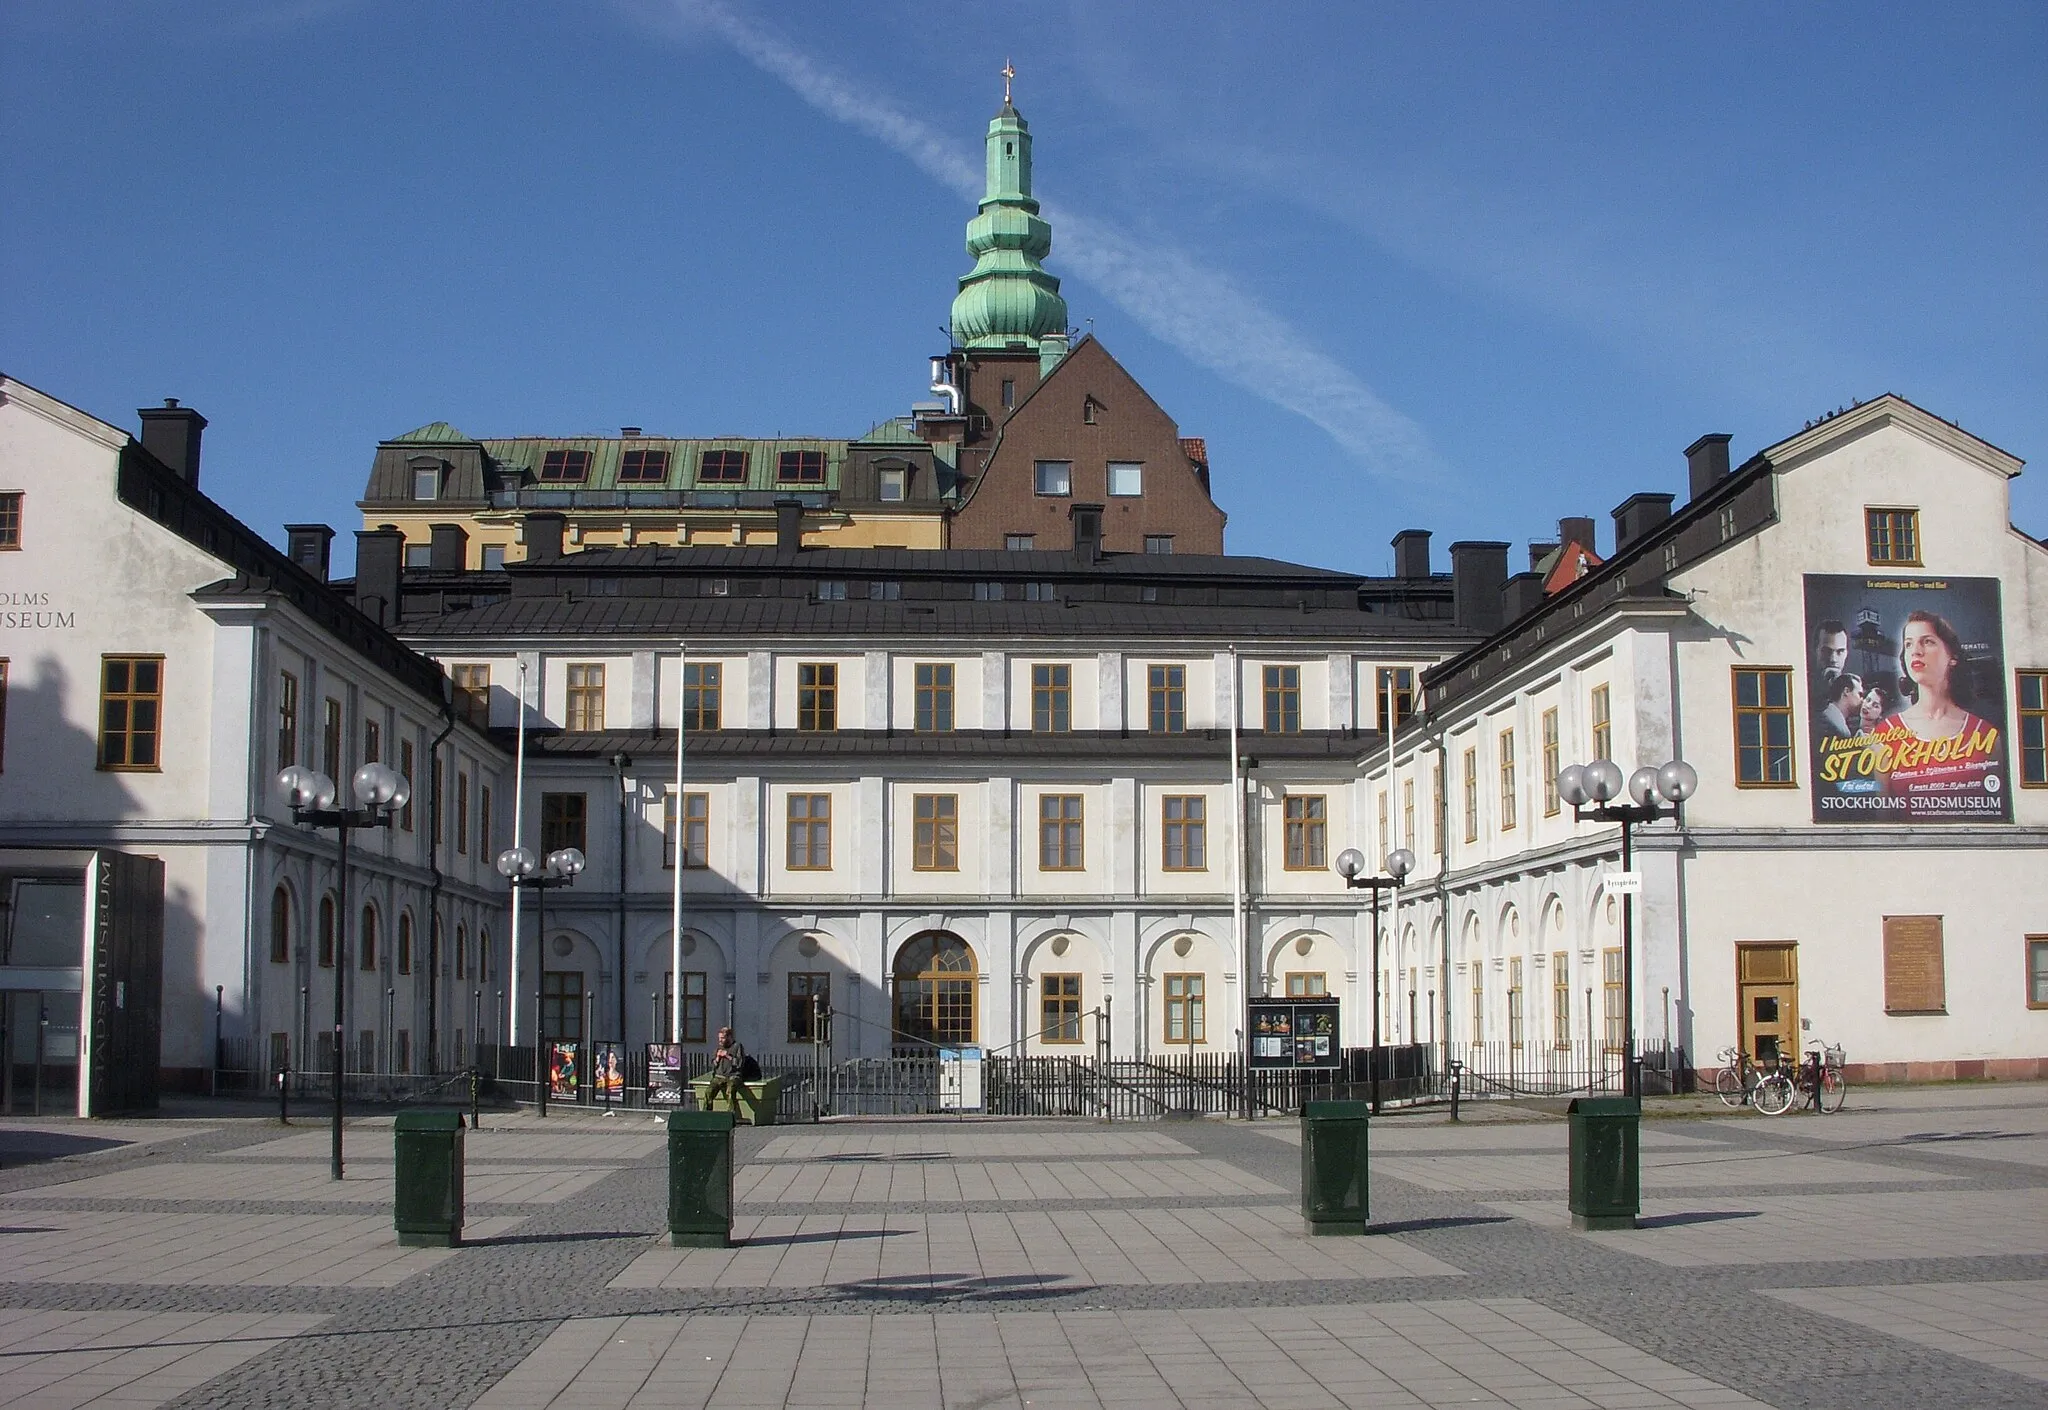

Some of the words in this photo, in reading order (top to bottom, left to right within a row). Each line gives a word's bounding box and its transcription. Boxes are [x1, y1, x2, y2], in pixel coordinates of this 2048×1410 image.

[0, 612, 75, 628] SEUM
[1819, 727, 1999, 782] STOCKHOLM
[1821, 796, 1907, 809] STOCKHOLMS
[1910, 796, 2001, 809] STADSMUSEUM
[95, 860, 112, 1093] STADSMUSEUM
